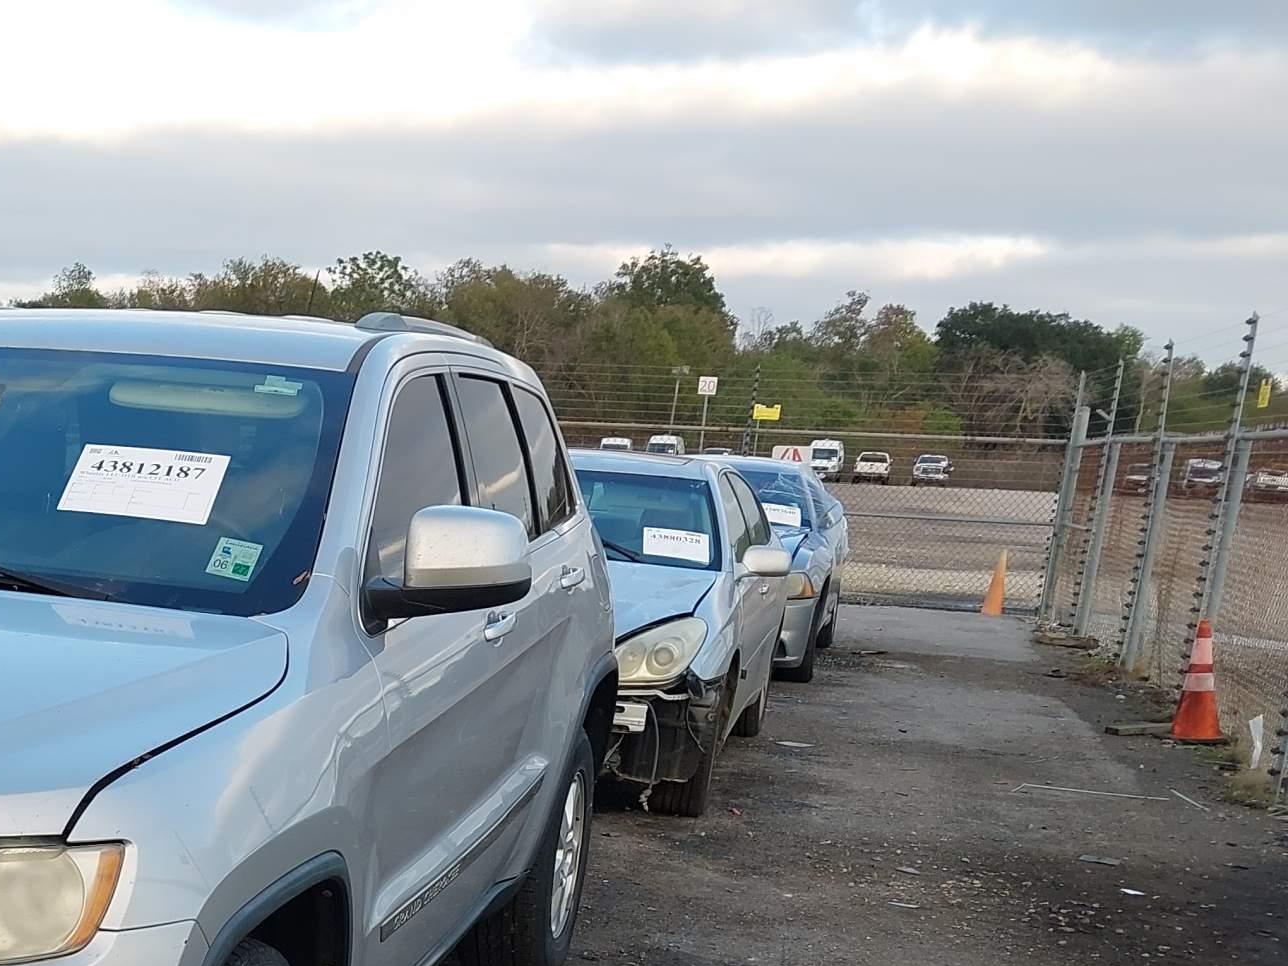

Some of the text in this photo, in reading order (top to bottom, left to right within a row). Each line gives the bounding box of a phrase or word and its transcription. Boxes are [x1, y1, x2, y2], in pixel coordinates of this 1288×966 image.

[699, 380, 716, 393] 20
[90, 459, 206, 480] 43812187
[213, 558, 229, 570] 06
